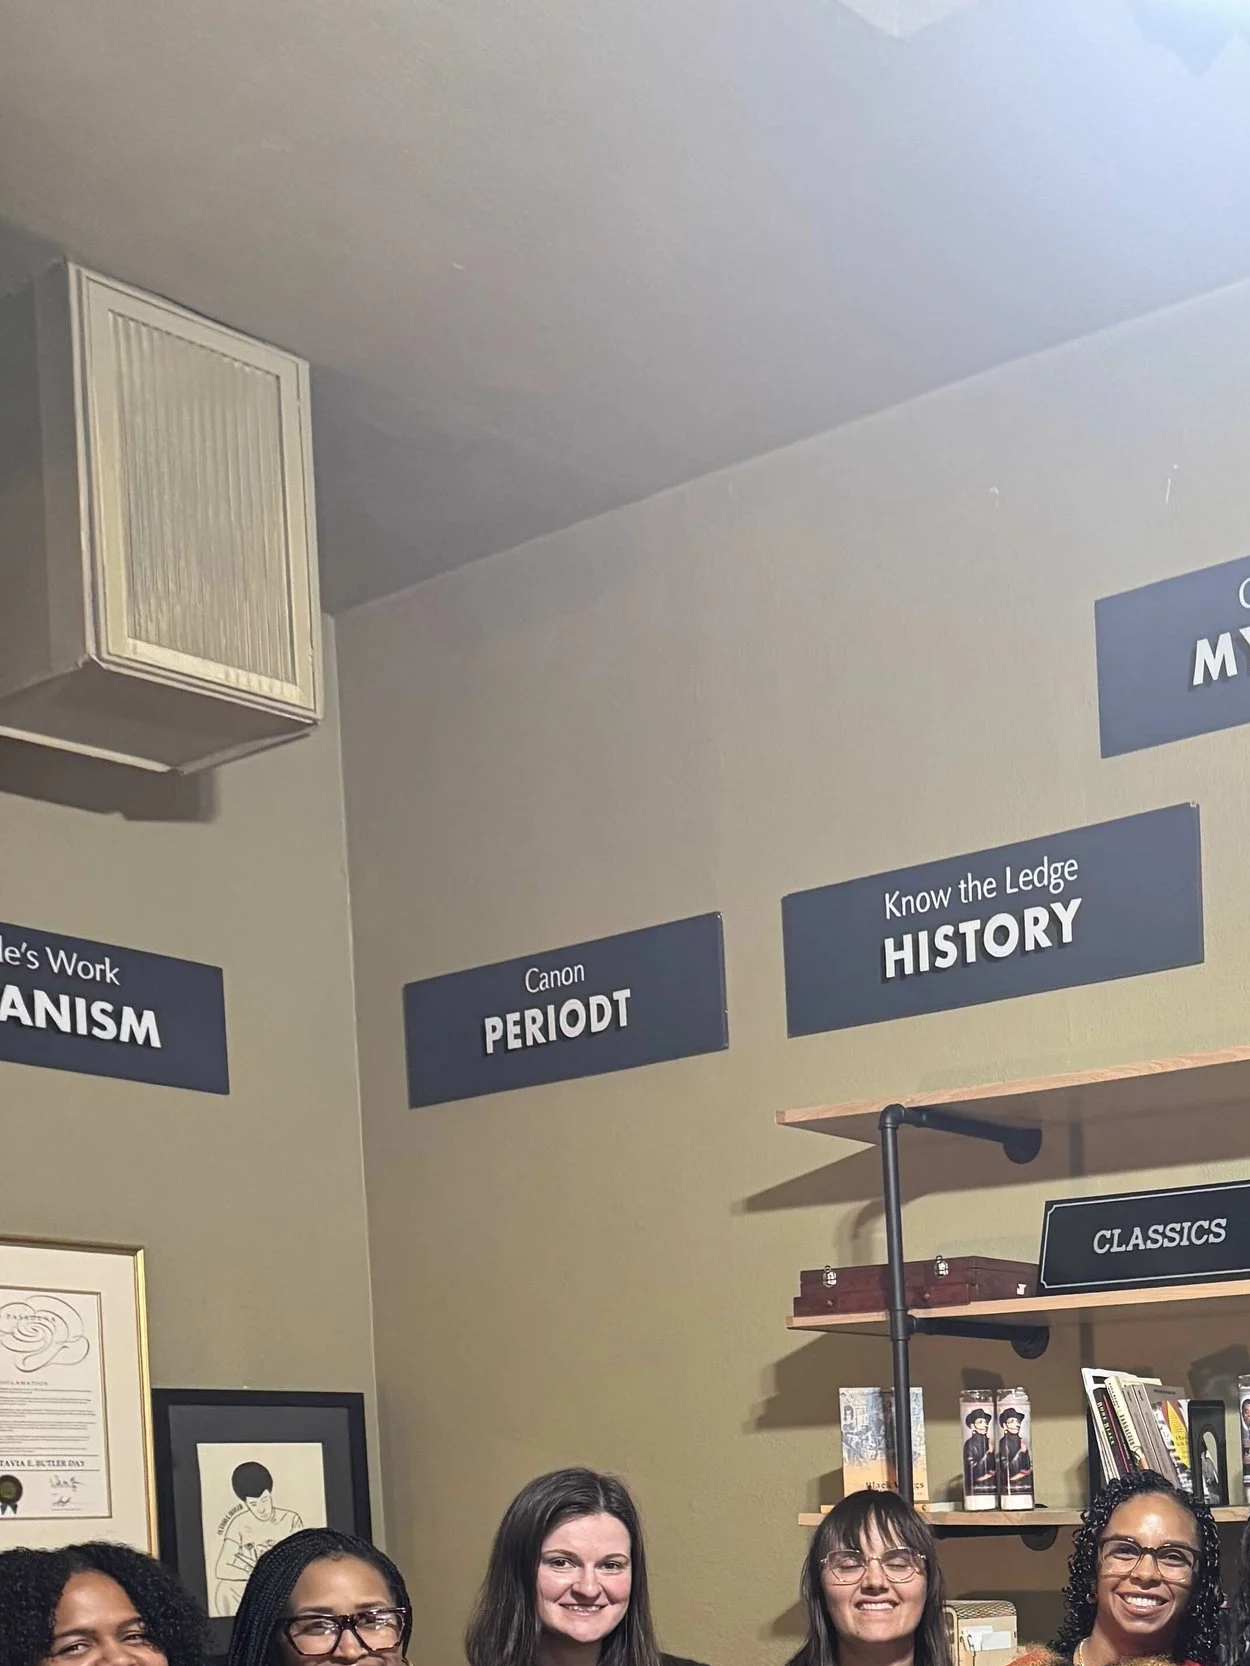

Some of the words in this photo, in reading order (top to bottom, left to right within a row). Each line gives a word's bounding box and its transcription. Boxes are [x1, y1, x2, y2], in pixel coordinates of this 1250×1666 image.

[884, 884, 951, 920] Know
[958, 871, 997, 904] the
[1004, 856, 1080, 901] Ledge
[46, 947, 120, 985] Work
[884, 898, 1083, 979] HISTORY
[524, 960, 585, 995] Canon
[0, 984, 162, 1048] ANISM
[484, 988, 632, 1054] PERIODT
[1094, 1218, 1227, 1255] CLASSICS
